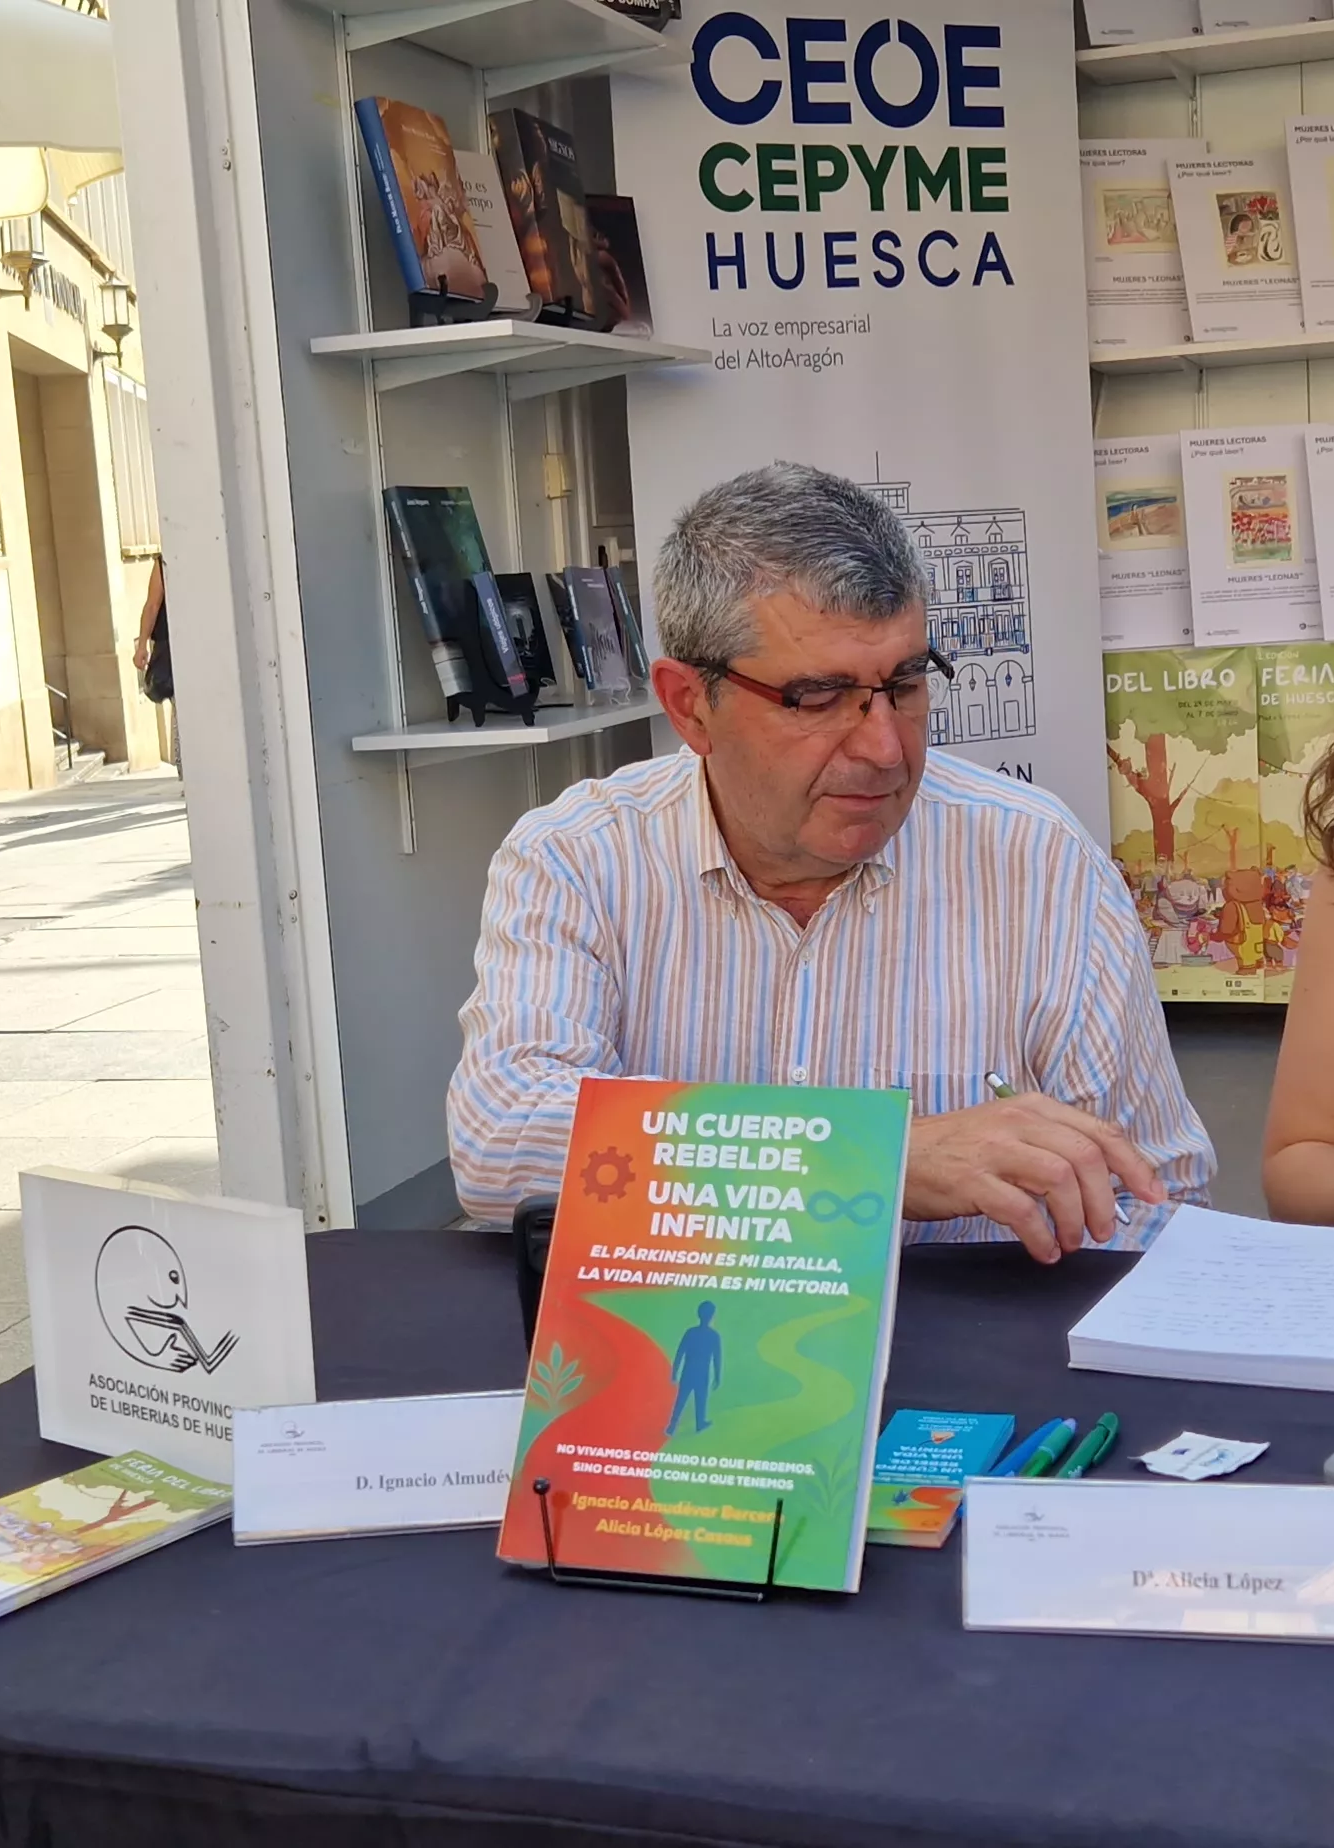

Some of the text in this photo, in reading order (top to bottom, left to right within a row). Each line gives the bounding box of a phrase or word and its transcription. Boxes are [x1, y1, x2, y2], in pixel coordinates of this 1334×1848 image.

[690, 12, 1005, 128] CEOE
[698, 142, 1009, 212] CEPYME
[705, 230, 1015, 290] HUESCA
[712, 314, 871, 340] La voz empresarial
[715, 348, 844, 373] del AltoAragón
[1106, 667, 1236, 693] DEL LIBRO
[1261, 662, 1334, 688] FERIA
[1261, 693, 1280, 706] DE
[642, 1111, 832, 1142] UN CUERPO
[653, 1142, 809, 1175] REBELDE,
[647, 1181, 805, 1212] UNA VIDA
[650, 1212, 792, 1243] INFINITA
[589, 1244, 843, 1274] EL PÁRKINSON ES MI BATALLA,
[578, 1266, 850, 1297] LA VIDA INFINITA ES MI VICTORIA
[89, 1372, 170, 1405] ASOCIACIÓN
[91, 1394, 109, 1412] DE
[111, 1397, 180, 1428] LIBRERIAS
[183, 1416, 202, 1434] DE
[557, 1443, 576, 1456] NO
[577, 1445, 631, 1461] VIVAMOS
[633, 1449, 700, 1466] CONTANDO
[701, 1455, 719, 1467] LO
[720, 1456, 745, 1470] QUE
[121, 1457, 164, 1478] FERIA
[162, 1475, 192, 1490] DEL
[355, 1475, 373, 1491] D.
[378, 1472, 437, 1493] Ignacio
[572, 1461, 794, 1491] SINO CREANDO CON LO QUE TENEMOS
[572, 1491, 629, 1513] Ignacio
[631, 1496, 719, 1521] Almudévar
[596, 1518, 640, 1536] Alicia
[643, 1521, 691, 1545] López
[1166, 1571, 1219, 1590] Alicia
[1226, 1571, 1284, 1595] López
